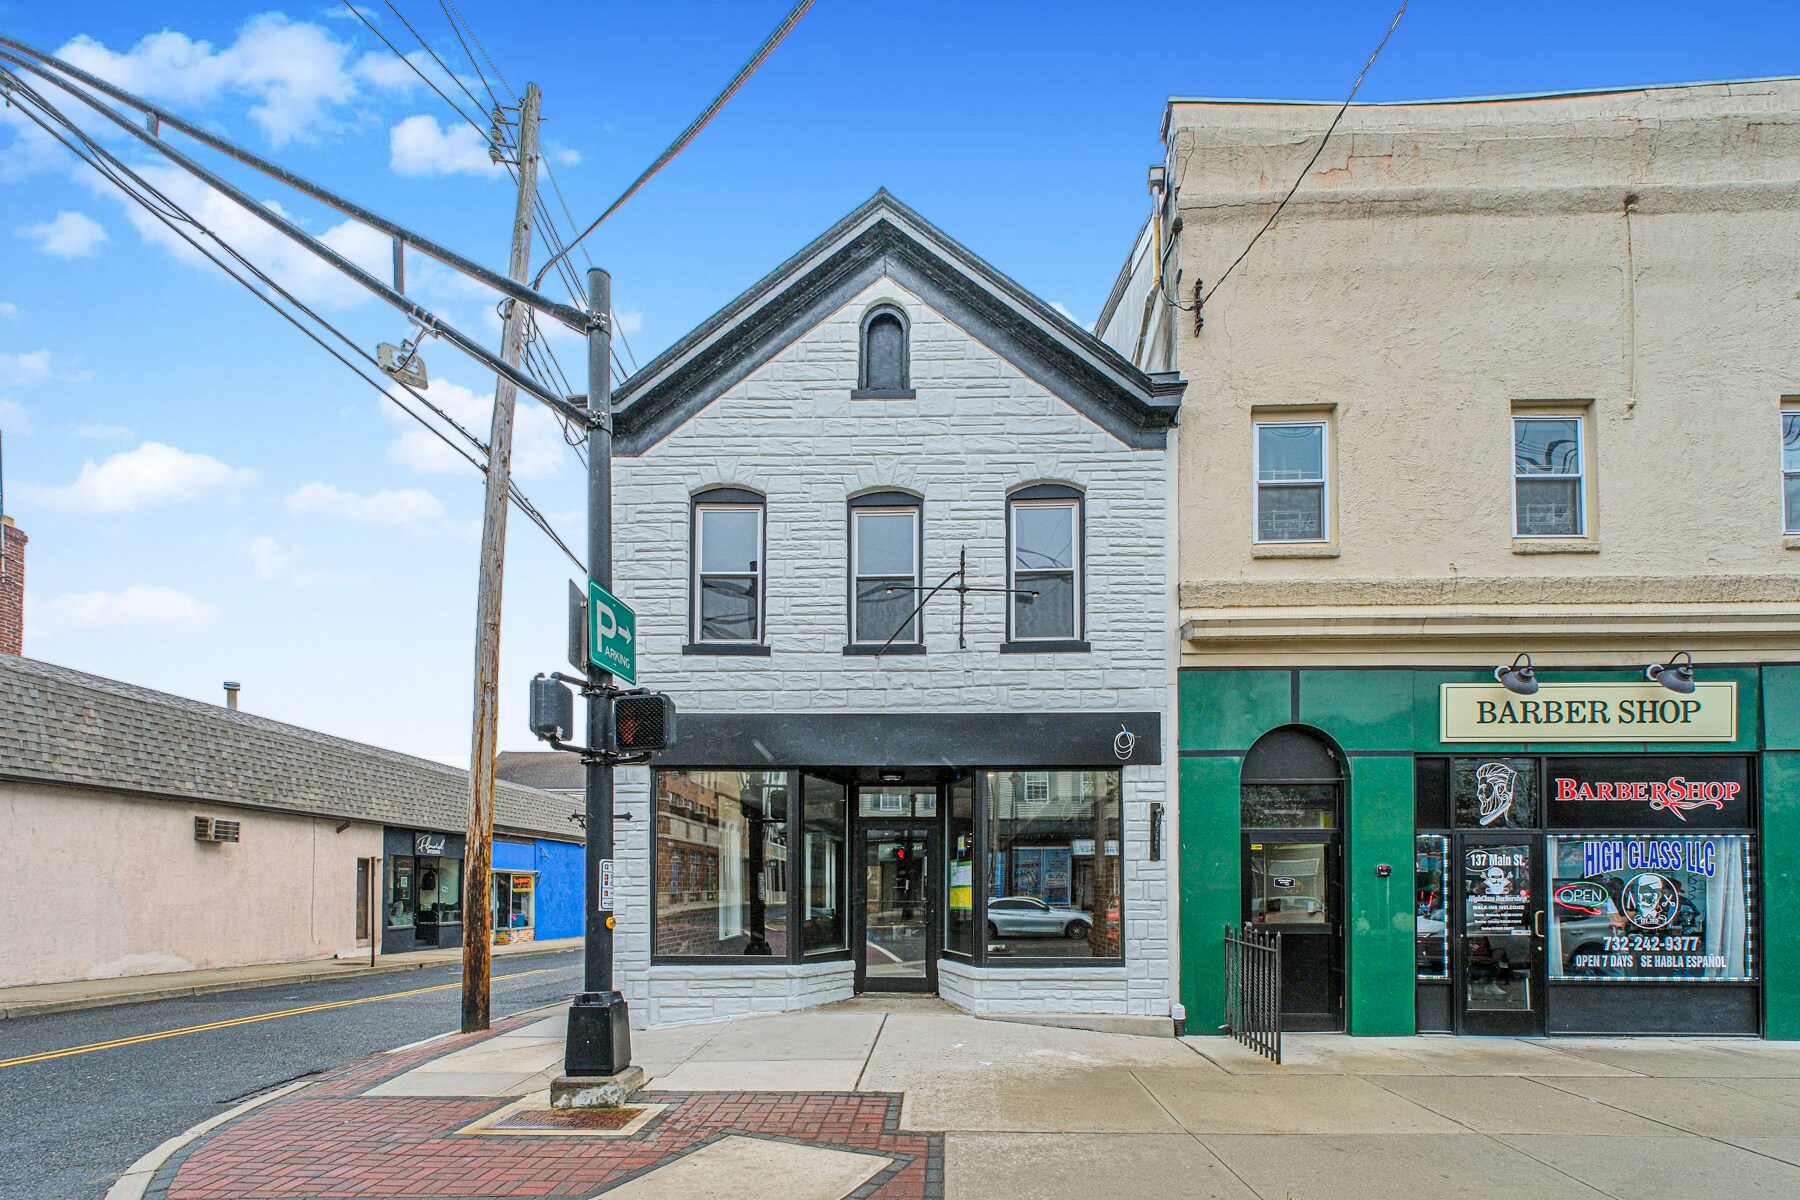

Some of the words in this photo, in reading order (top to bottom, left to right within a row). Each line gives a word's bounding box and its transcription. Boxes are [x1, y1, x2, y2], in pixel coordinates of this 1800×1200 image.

[1476, 700, 1611, 724] BARBER
[1618, 700, 1702, 724] SHOP
[1470, 853, 1487, 866] 137
[1489, 853, 1512, 866] Main
[1513, 853, 1526, 867] St.
[1584, 842, 1624, 879] HIGH
[1628, 841, 1683, 870] CLASS
[1686, 841, 1716, 878] LLC
[1560, 889, 1602, 903] OPEN
[1603, 936, 1699, 951] 732-242-9377
[1575, 955, 1600, 967] OPEN
[1602, 955, 1608, 967] 7
[1610, 955, 1633, 967] DAYS
[1640, 955, 1652, 967] SE
[1654, 955, 1684, 967] HABLA
[1685, 953, 1727, 968] ESPAÑOL
